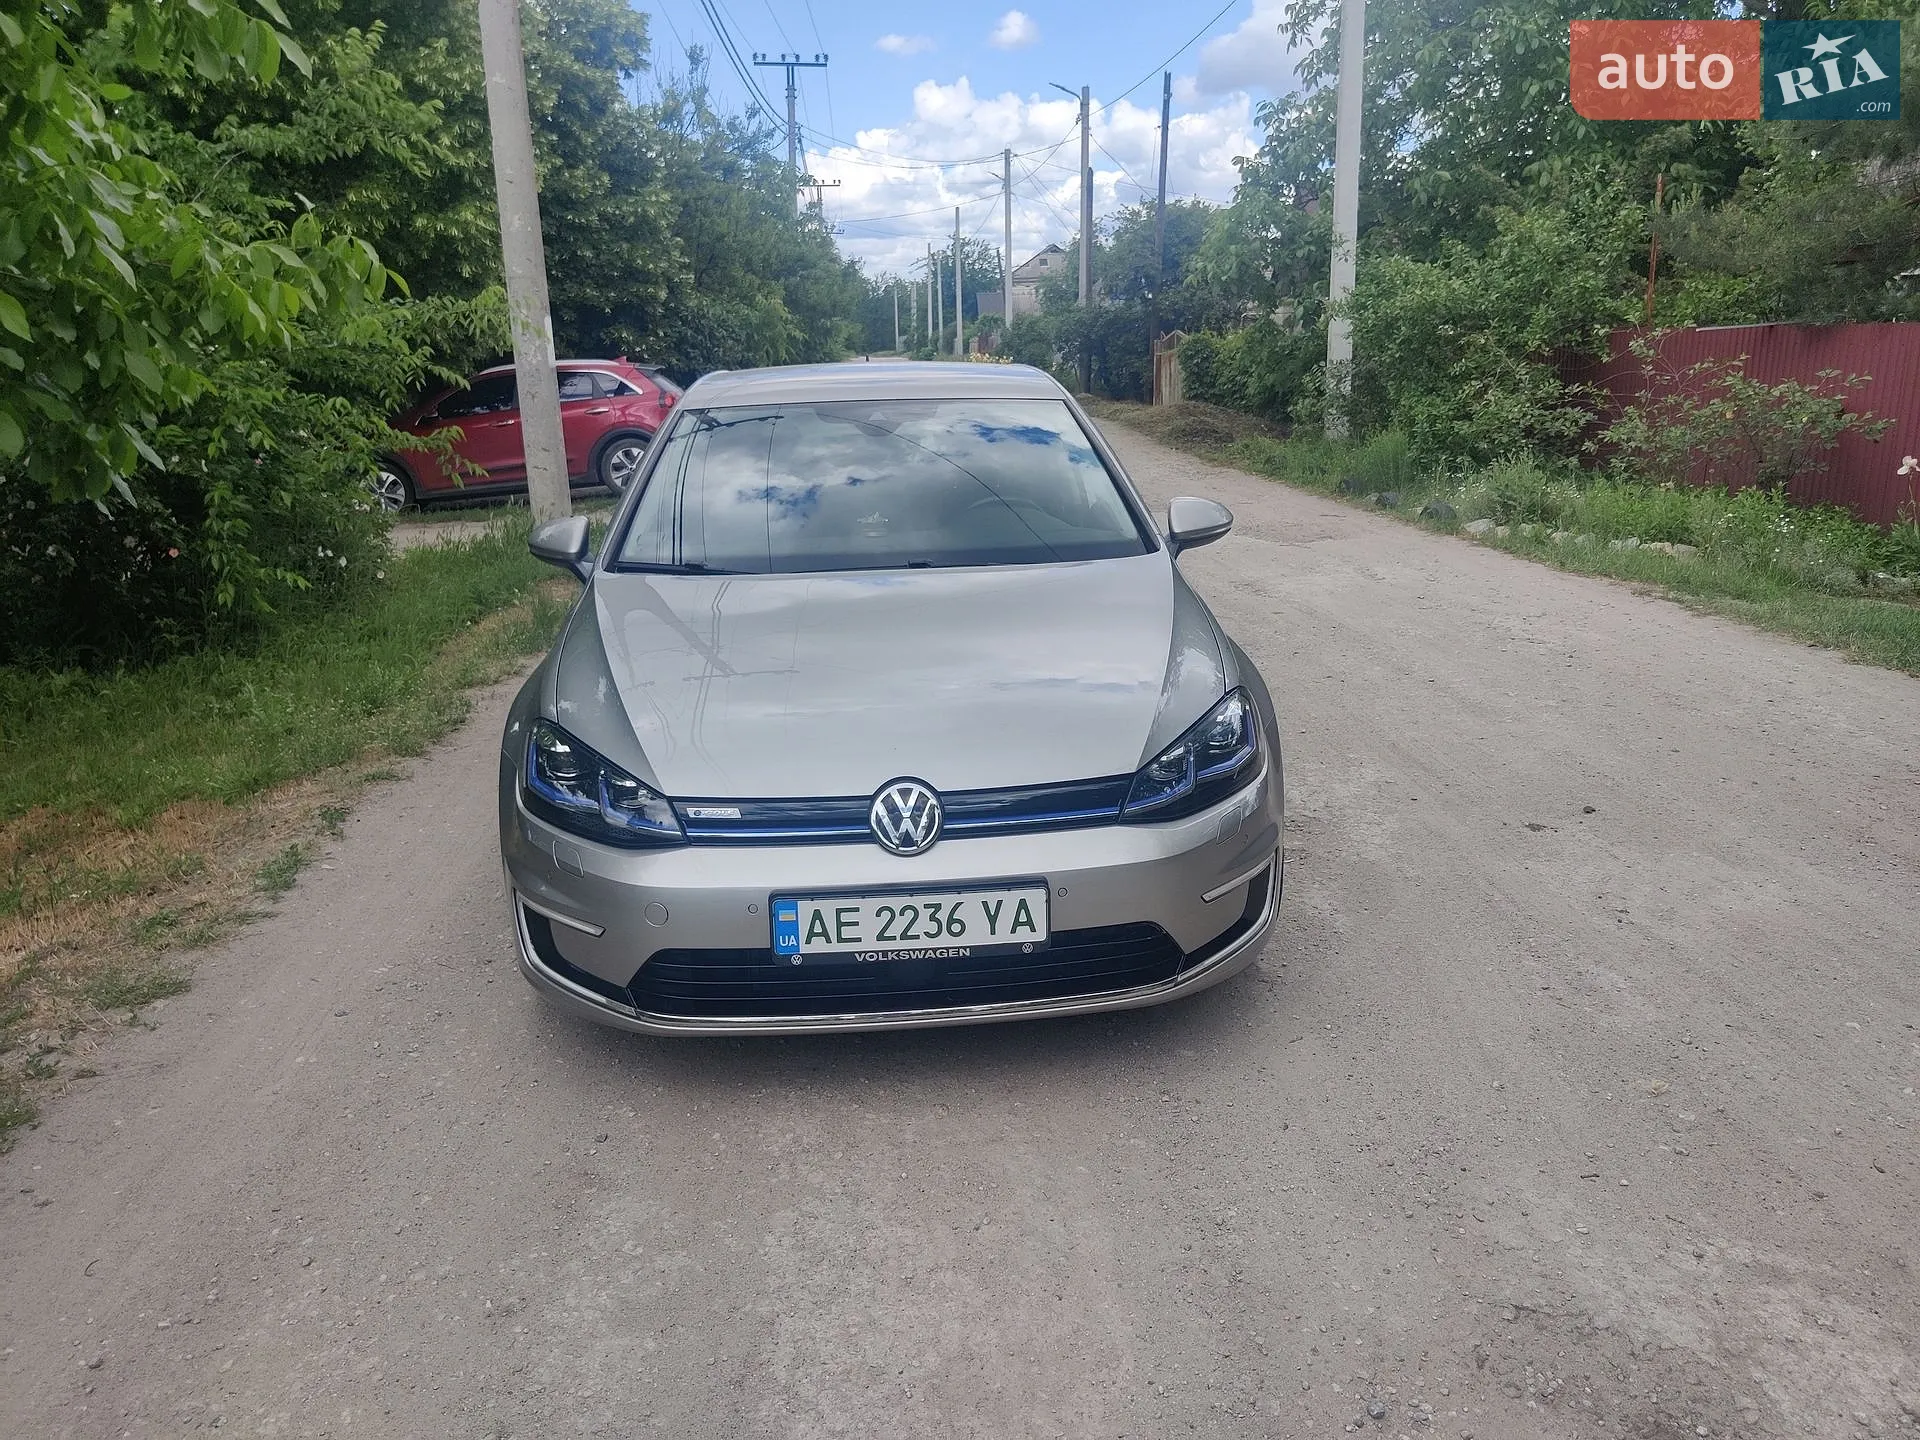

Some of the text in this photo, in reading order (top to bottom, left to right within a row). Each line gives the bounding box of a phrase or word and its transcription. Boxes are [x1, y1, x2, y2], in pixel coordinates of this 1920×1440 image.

[804, 898, 1037, 945] AE 2236 YA
[779, 935, 798, 947] UA
[854, 947, 971, 962] VOLKSWAGEN
